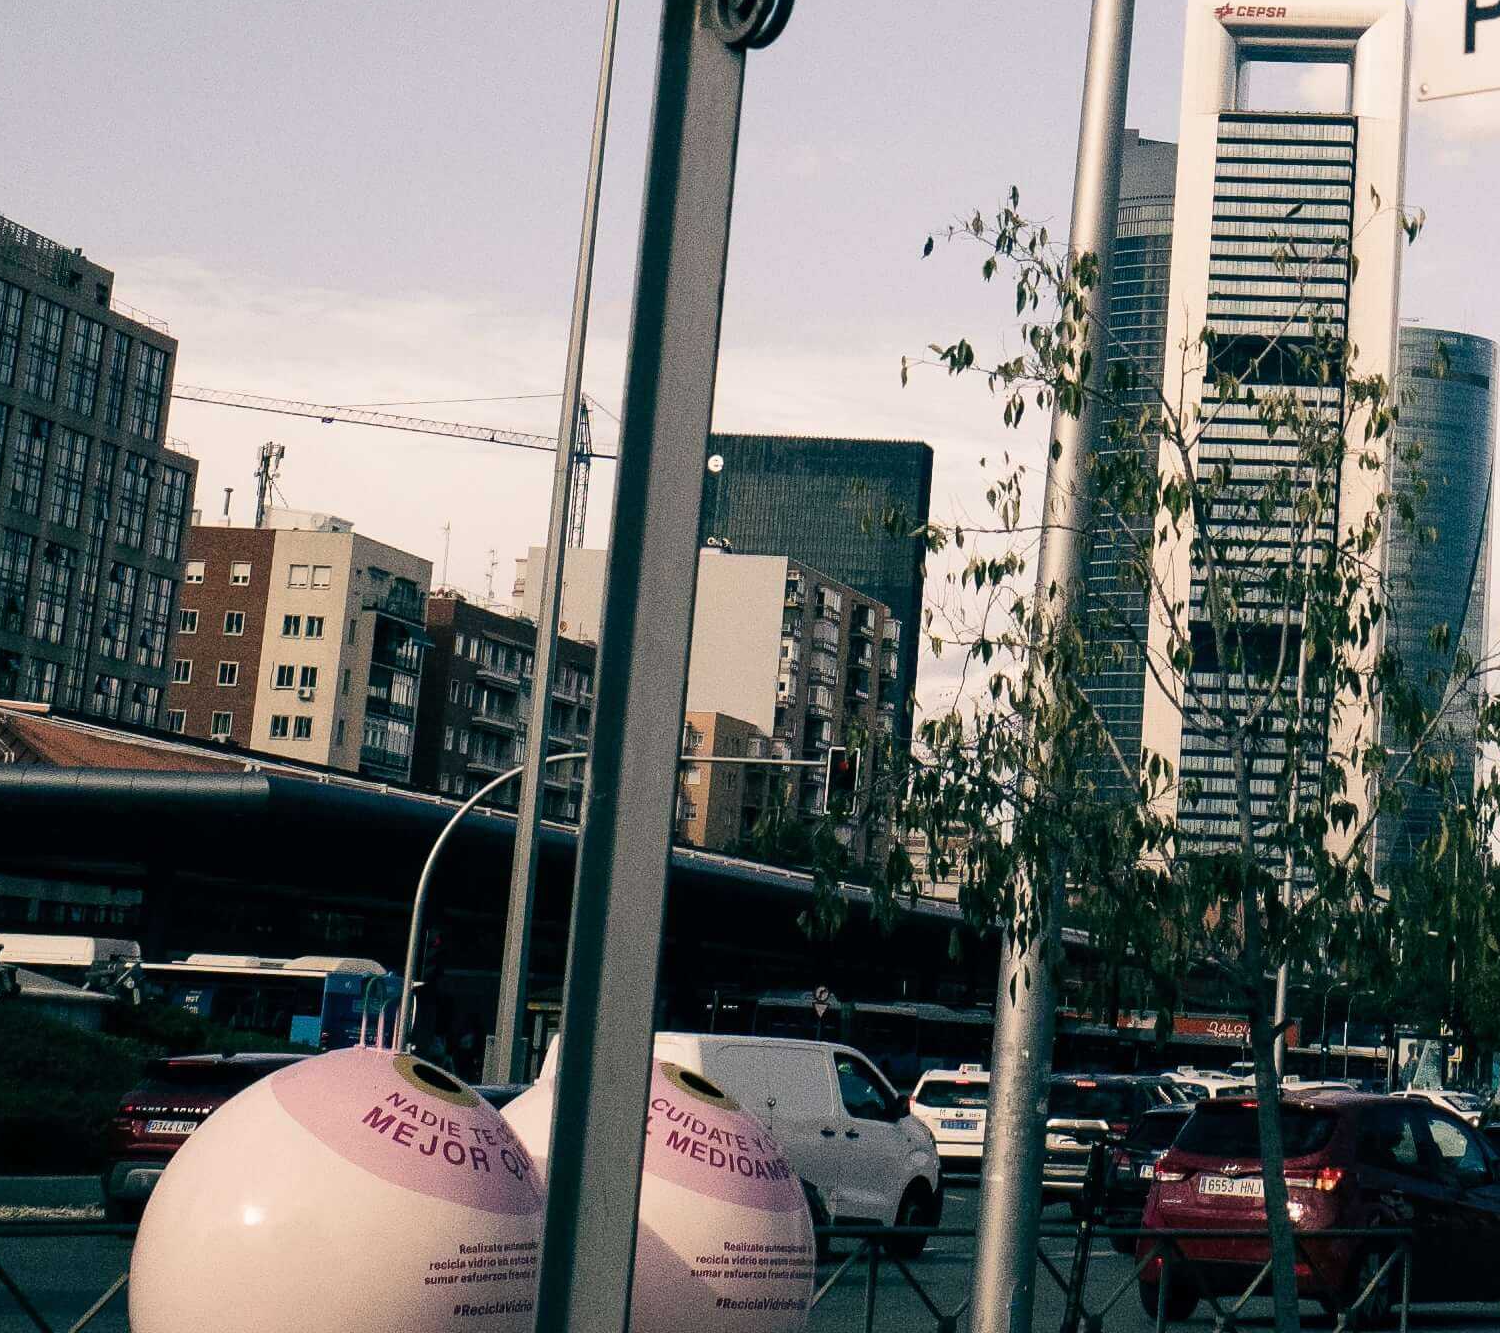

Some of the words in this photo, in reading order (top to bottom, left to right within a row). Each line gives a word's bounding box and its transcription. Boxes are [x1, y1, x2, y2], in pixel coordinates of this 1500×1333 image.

[1236, 5, 1286, 18] CEPSA
[385, 1091, 461, 1138] NADIE
[468, 1127, 498, 1146] TE
[362, 1106, 491, 1173] MEJOR
[429, 1258, 466, 1271] recicla
[468, 1256, 496, 1268] vidrio
[695, 1255, 730, 1265] recicla
[732, 1255, 757, 1265] vidrio
[424, 1274, 459, 1285] sumar
[461, 1271, 507, 1283] esfuerzos
[690, 1269, 722, 1278] sumar
[723, 1269, 767, 1278] esfuerzos
